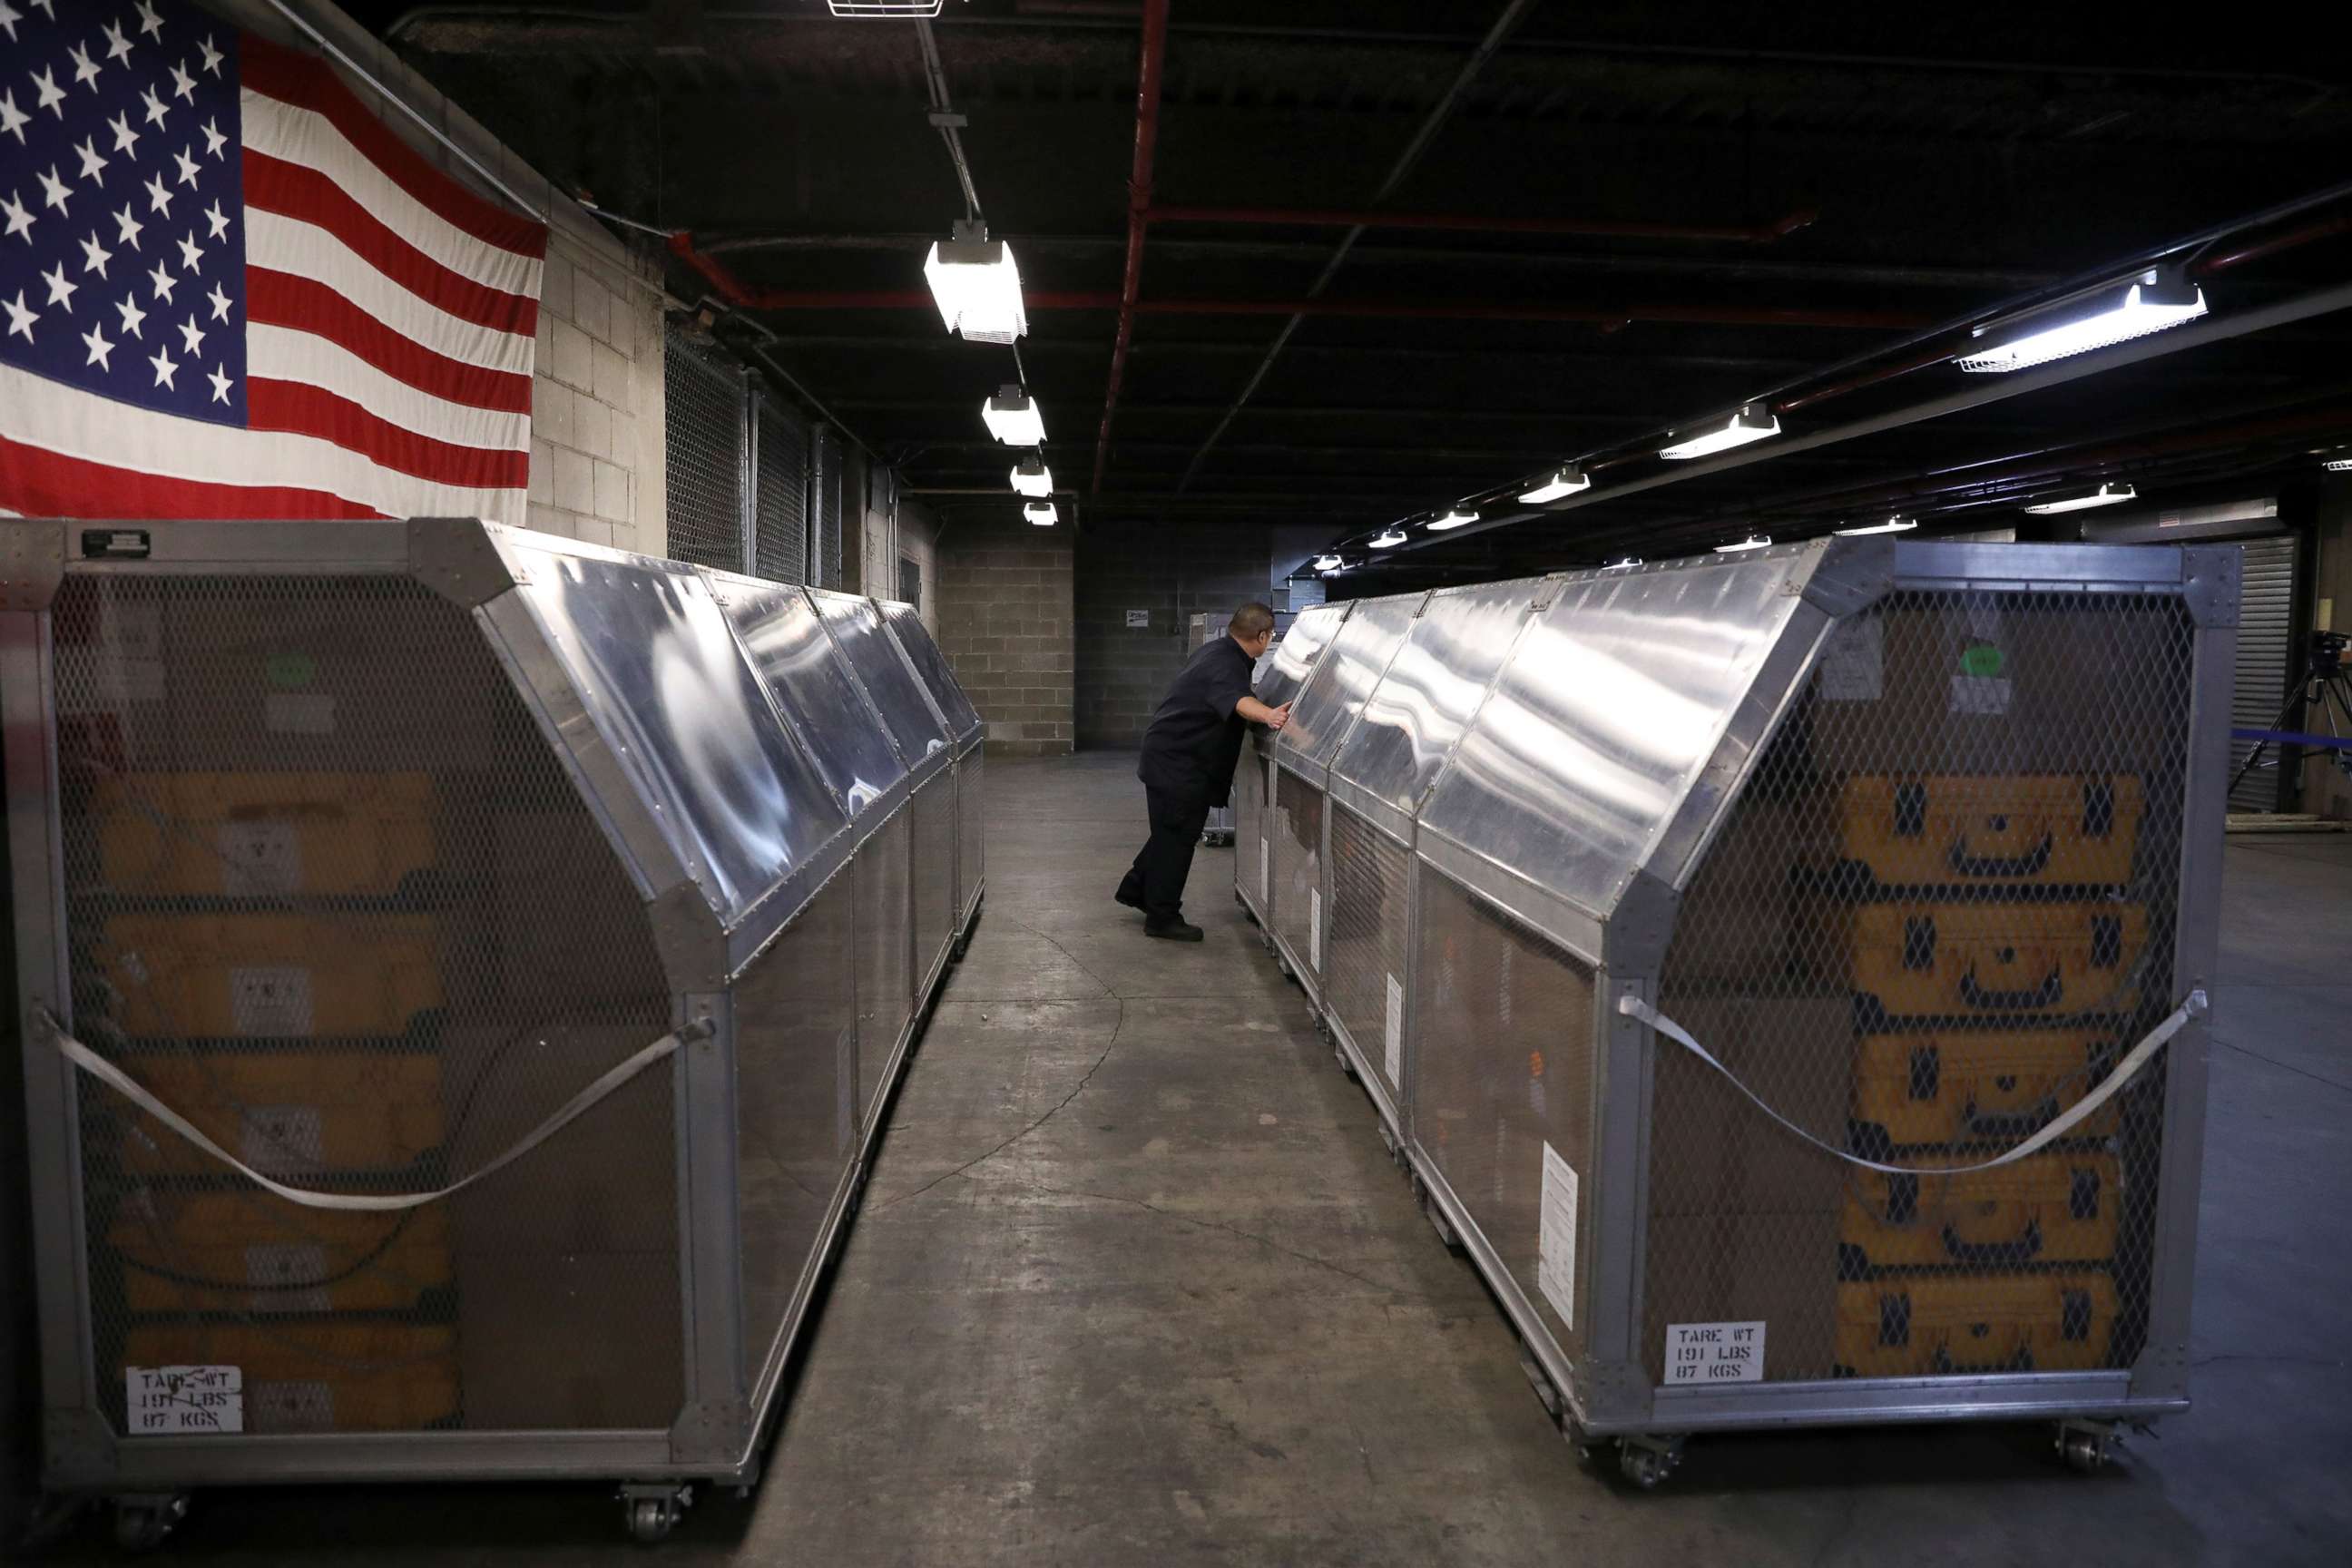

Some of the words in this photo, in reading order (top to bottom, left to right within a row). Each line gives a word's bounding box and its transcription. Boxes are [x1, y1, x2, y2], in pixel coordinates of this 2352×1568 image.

[1679, 1329, 1722, 1342] TARE
[1733, 1328, 1754, 1341] WT
[1678, 1348, 1704, 1361] 191
[1719, 1346, 1751, 1359] LBS
[1677, 1365, 1697, 1378] 87
[1709, 1364, 1741, 1377] KGS
[142, 1394, 173, 1407] 191
[190, 1392, 227, 1406] LBS
[143, 1413, 166, 1427] 87
[181, 1412, 219, 1427] KGS
